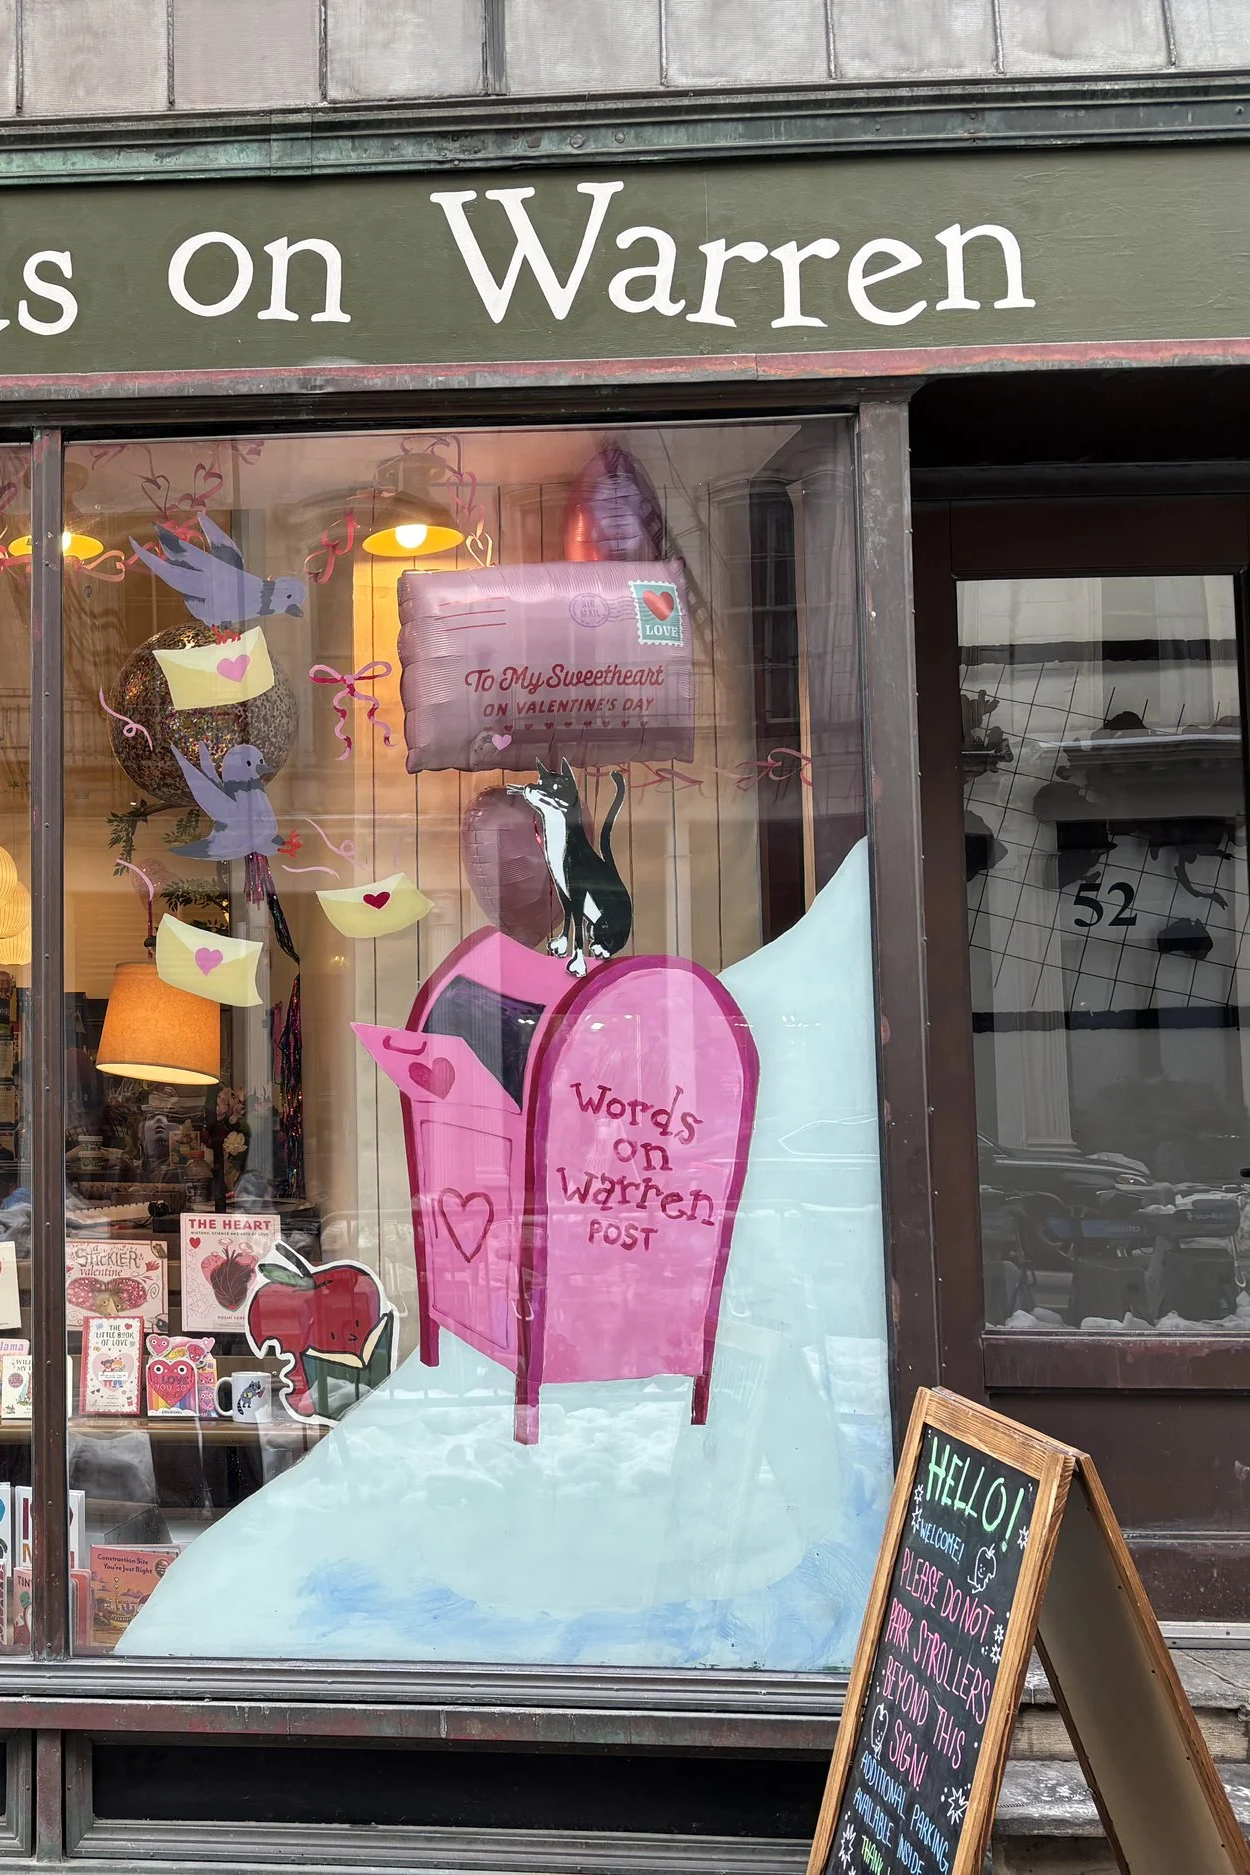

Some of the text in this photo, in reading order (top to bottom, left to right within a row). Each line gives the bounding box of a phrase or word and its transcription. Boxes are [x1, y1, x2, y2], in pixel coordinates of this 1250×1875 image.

[168, 230, 350, 323] on
[430, 181, 1036, 329] Warren
[580, 608, 602, 619] MAIL
[581, 599, 596, 609] AIR
[644, 624, 679, 638] LOVE
[464, 663, 664, 695] To My Sweetheart
[483, 697, 655, 718] ON VALENTINE'S DAY
[1073, 881, 1138, 927] 52
[570, 1082, 704, 1145] Words
[613, 1137, 673, 1171] on
[556, 1167, 715, 1226] Warren
[188, 1219, 271, 1230] THE HEART
[588, 1219, 658, 1251] POST
[80, 1265, 123, 1277] valentine
[161, 1375, 189, 1385] LOVE
[926, 1437, 1025, 1553] HELLO!
[22, 1498, 30, 1540] I
[97, 1553, 149, 1565] Construction Site
[919, 1519, 965, 1565] WELCOME!
[103, 1562, 122, 1571] You're
[135, 1566, 153, 1575] Right
[900, 1548, 996, 1643] PLEASE DO NOT
[885, 1598, 991, 1725] PARK STROLLERS
[882, 1655, 966, 1769] BEYOND THIS
[888, 1719, 930, 1791] SIGN!
[852, 1786, 895, 1848] AVAILABLE
[860, 1751, 949, 1874] ADDITIONAL PARKING
